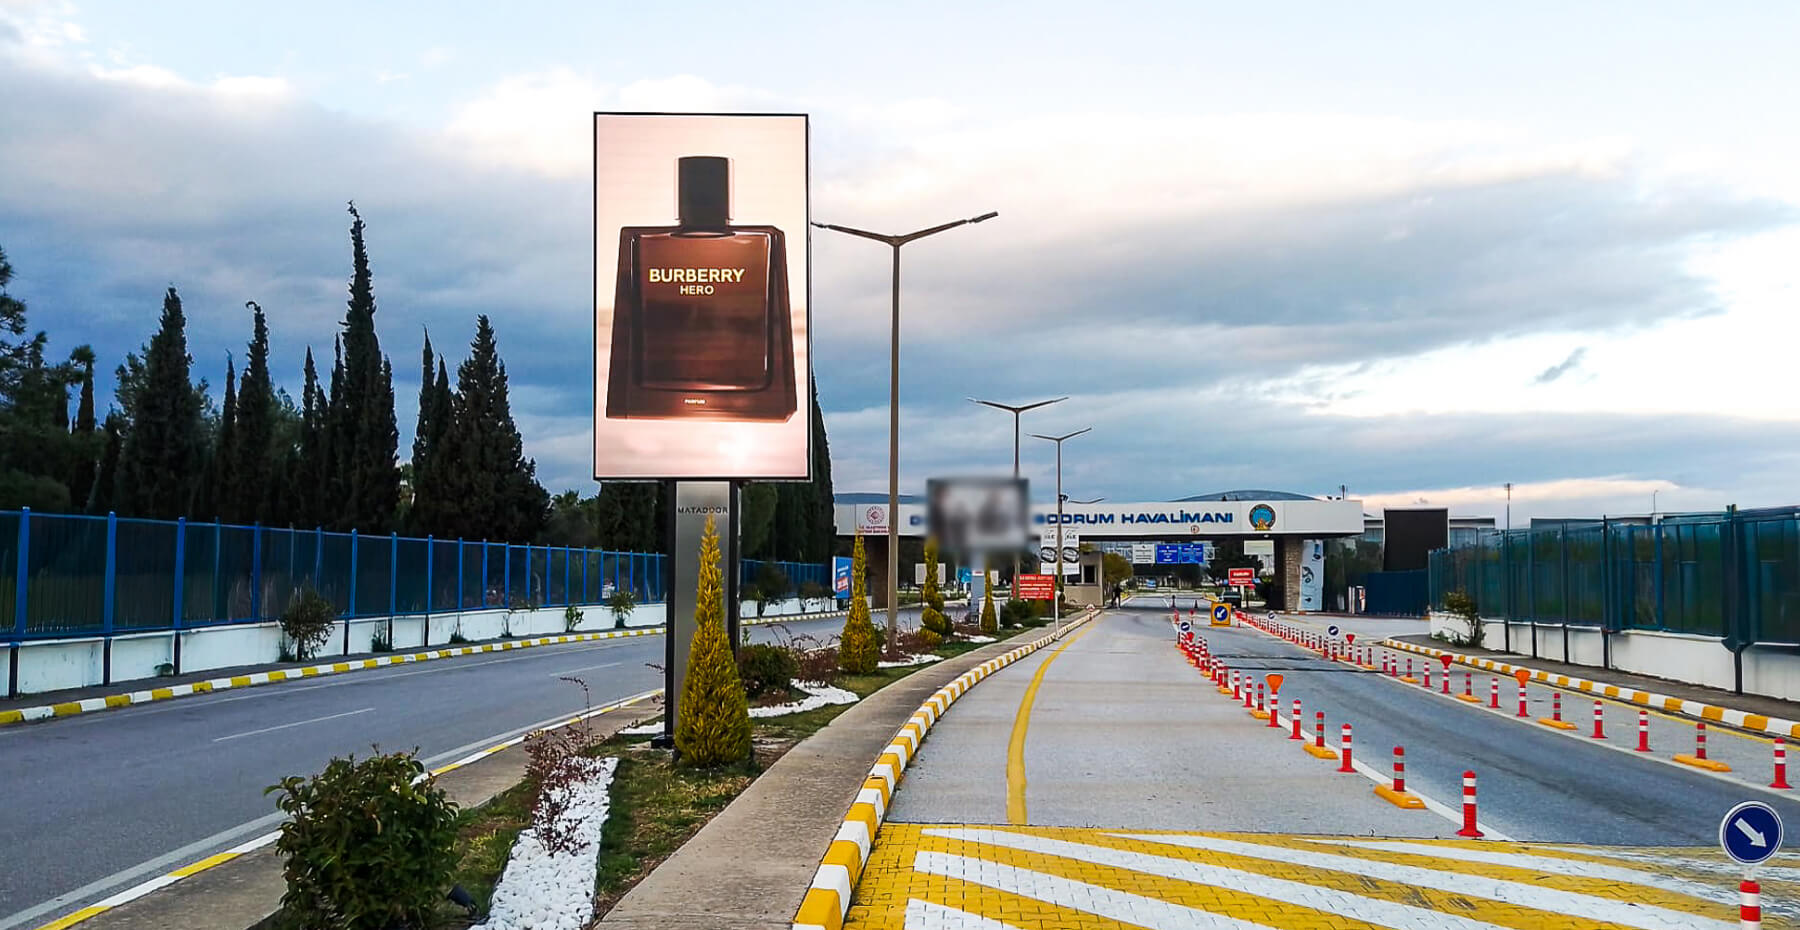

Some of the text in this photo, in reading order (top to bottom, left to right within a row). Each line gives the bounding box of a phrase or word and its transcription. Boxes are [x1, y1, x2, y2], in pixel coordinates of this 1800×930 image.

[649, 268, 745, 283] BURBERRY
[680, 285, 714, 295] HERO
[1034, 513, 1115, 524] ODRUM
[1121, 509, 1234, 524] HAVALİMANI
